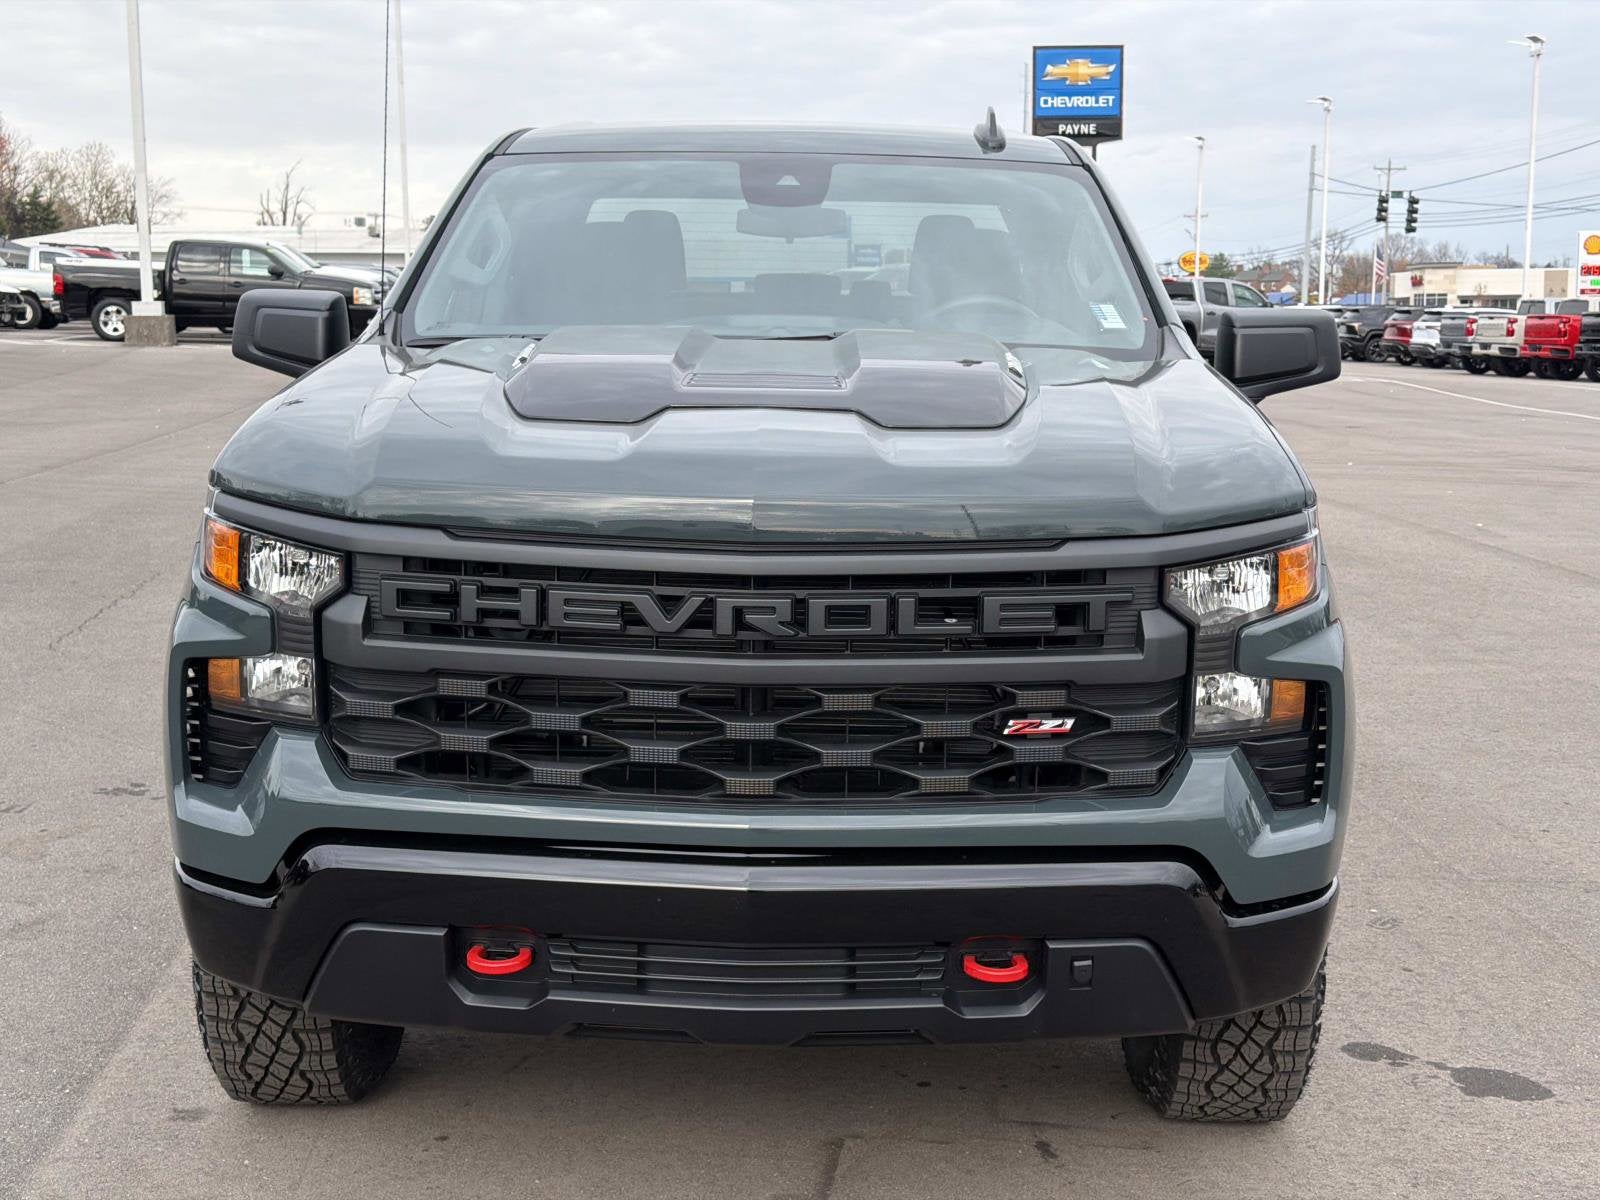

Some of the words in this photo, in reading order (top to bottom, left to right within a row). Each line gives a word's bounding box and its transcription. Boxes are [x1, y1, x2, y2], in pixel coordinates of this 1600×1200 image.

[1040, 96, 1114, 108] CHEVROLET
[1058, 124, 1096, 135] PAYNE
[380, 572, 1136, 638] CHEVROLET
[1002, 718, 1076, 735] Z71
